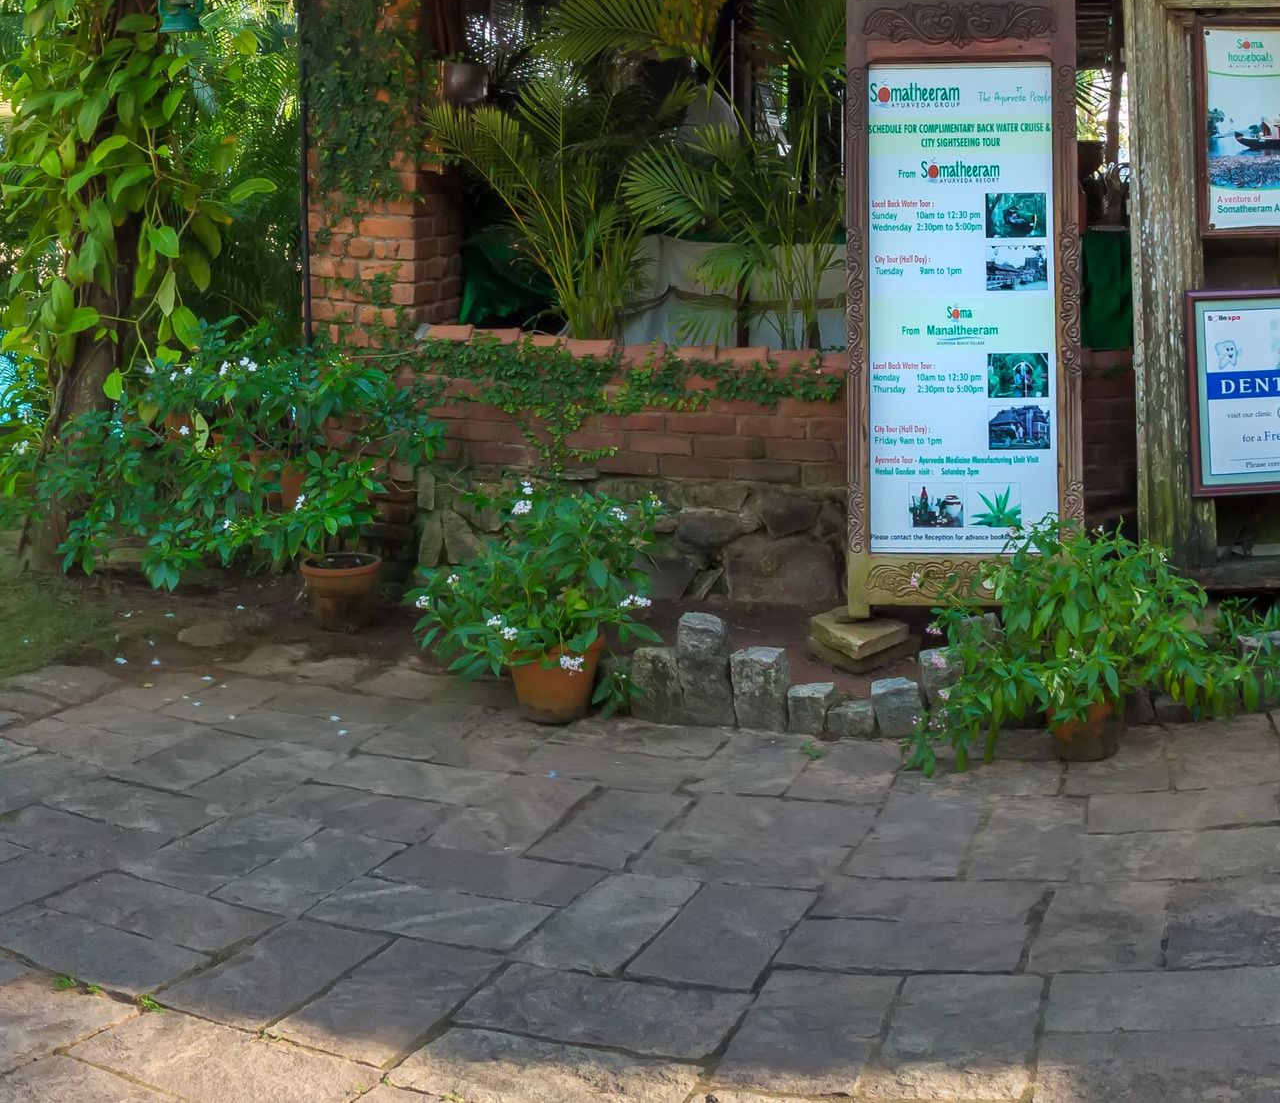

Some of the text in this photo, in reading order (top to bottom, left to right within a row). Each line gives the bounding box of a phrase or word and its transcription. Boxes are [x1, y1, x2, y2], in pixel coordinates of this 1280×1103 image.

[1237, 39, 1264, 50] Soma
[870, 82, 960, 103] Somatheeram
[978, 91, 991, 102] The
[868, 123, 1051, 134] SCHEDULE FOR COMPLIMENTARY BACK WATER CRUISE &
[921, 138, 1000, 147] CITY SIGHTSEEING TOUR
[898, 161, 1000, 179] From Somatheeram
[1253, 194, 1261, 202] of
[872, 200, 886, 208] Local
[1217, 204, 1273, 213] Somatheeram
[872, 211, 898, 221] Sunday
[916, 211, 935, 219] 10am
[936, 211, 945, 219] to
[947, 211, 967, 219] 12:30
[872, 223, 983, 233] Wednesday 2:30pm to 5:00pm
[875, 255, 885, 265] City
[886, 255, 898, 263] Tour
[899, 255, 913, 264] (Half
[875, 267, 962, 277] Tuesday 9am to 1pm
[946, 306, 972, 319] Soma
[902, 325, 998, 336] From Manaltheeram
[873, 362, 887, 370] Local
[888, 362, 901, 370] Back
[902, 362, 919, 370] Water
[873, 373, 900, 383] Monday
[917, 373, 935, 381] 10am
[937, 373, 945, 381] to
[948, 373, 969, 381] 12:30
[873, 385, 984, 394] Thursday 2:30pm to 5:00pm
[874, 426, 885, 434] City
[886, 425, 898, 433] Tour
[899, 425, 914, 434] (Half
[874, 436, 942, 446] Friday 9am to 1pm
[1242, 434, 1254, 443] for
[874, 455, 1039, 465] Ayurveda Tour Ayurveda Medicine Manufacturing Unit Visit
[1245, 460, 1266, 469] Please
[874, 467, 894, 475] Herbal
[895, 467, 916, 475] Garden
[941, 467, 966, 476] Saturday
[967, 467, 979, 476] 3pm
[925, 534, 953, 542] Reception
